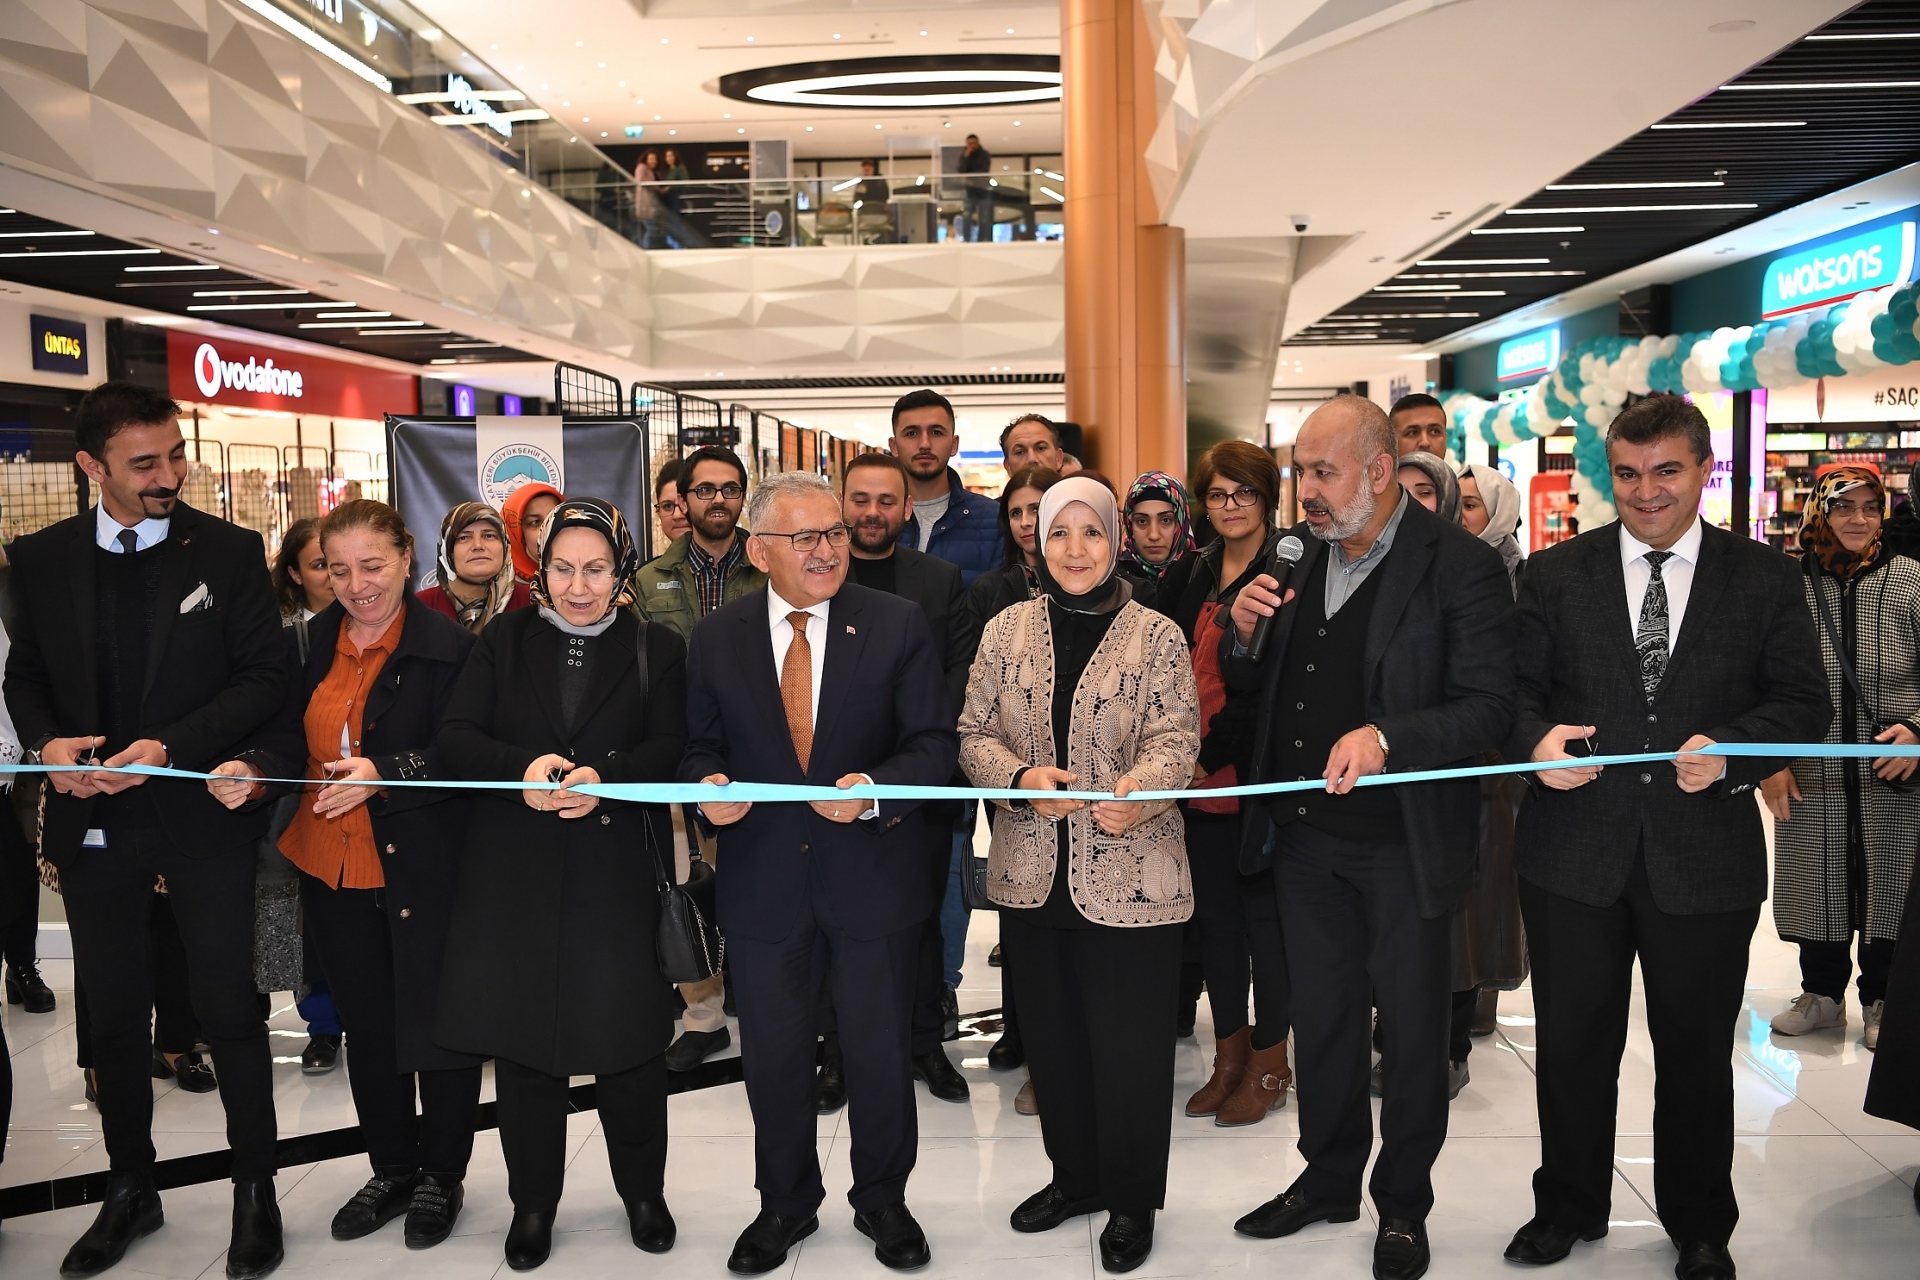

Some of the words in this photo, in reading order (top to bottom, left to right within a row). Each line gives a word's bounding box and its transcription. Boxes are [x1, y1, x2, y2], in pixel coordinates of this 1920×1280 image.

[1777, 244, 1882, 300] watsons
[44, 331, 81, 360] ÜNTAŞ
[220, 356, 303, 398] vodafone
[485, 464, 496, 500] KAYSERİ
[493, 447, 541, 465] BÜYÜKŞEHİR
